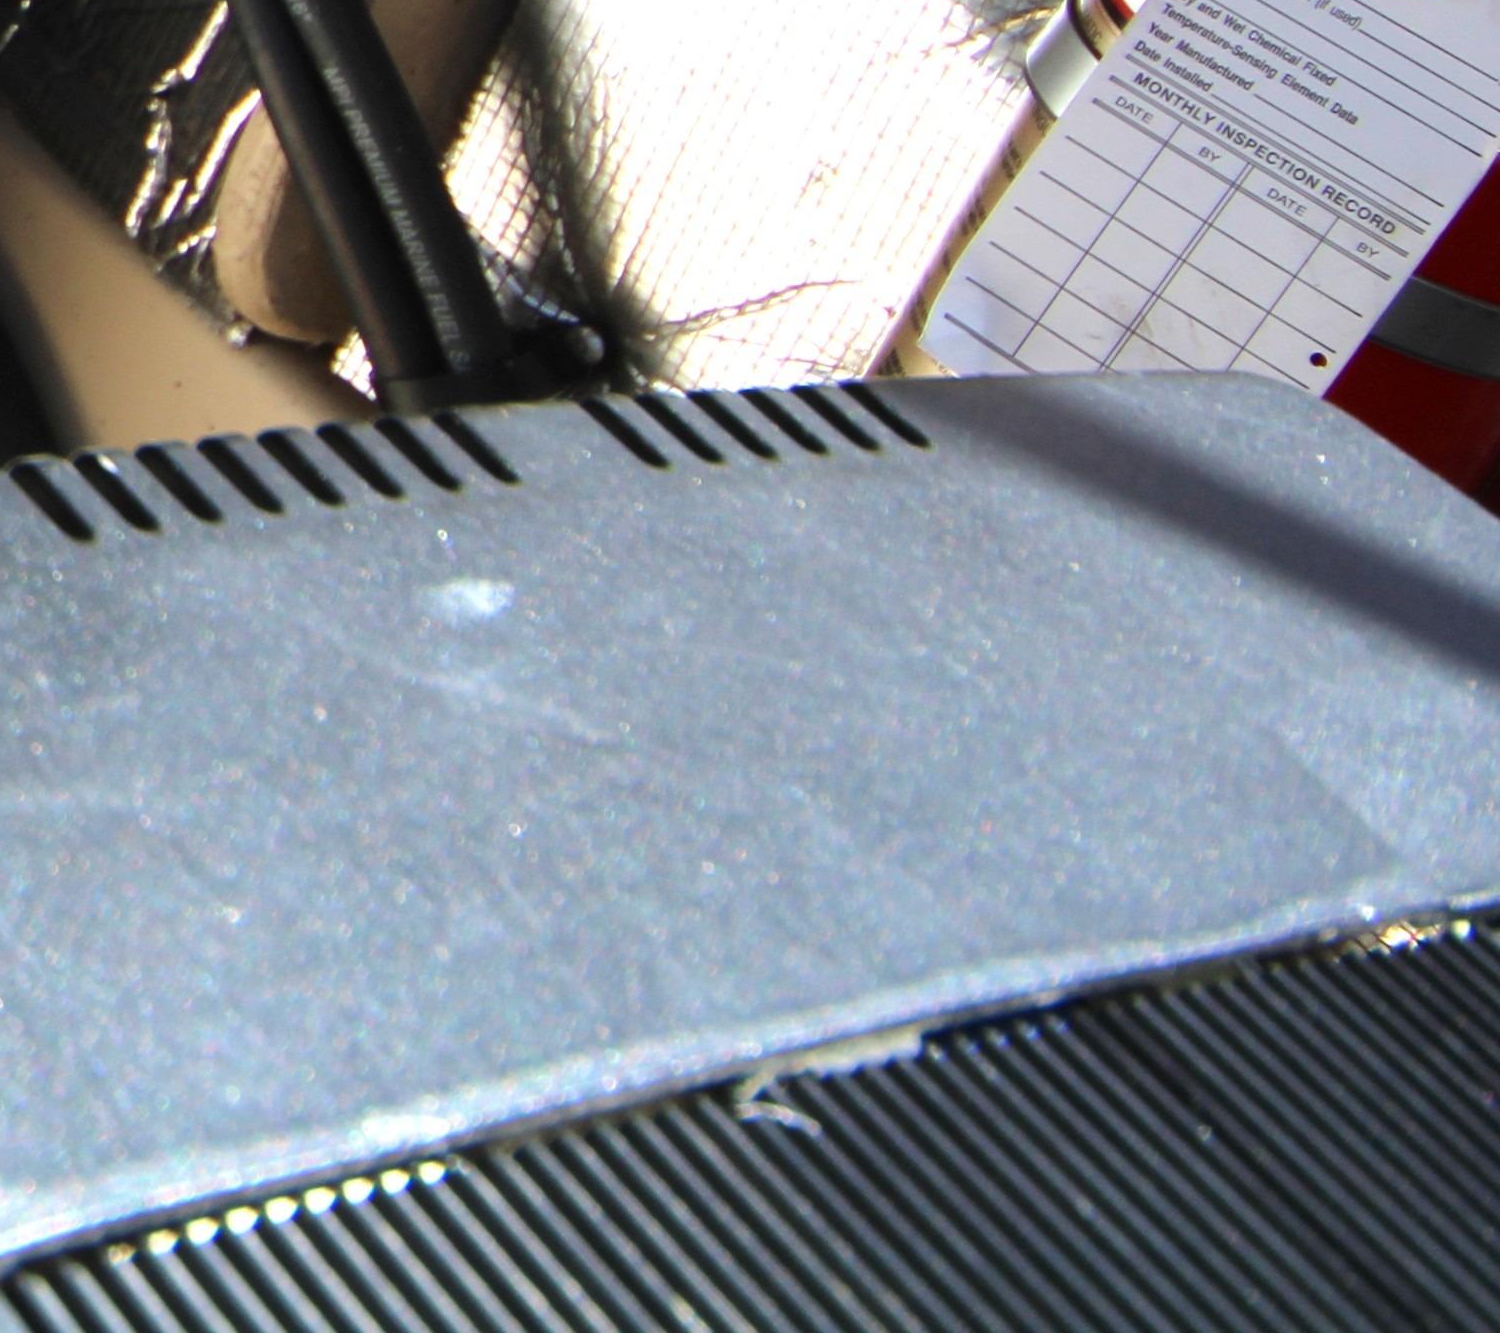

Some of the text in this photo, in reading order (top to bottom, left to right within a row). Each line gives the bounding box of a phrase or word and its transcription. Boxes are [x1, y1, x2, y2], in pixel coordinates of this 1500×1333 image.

[1196, 2, 1221, 19] and
[1223, 13, 1246, 34] Wet
[1247, 29, 1302, 65] Chemical
[1302, 61, 1337, 86] Fixed
[1329, 6, 1362, 31] used)
[1133, 39, 1213, 91] Date Installed
[1148, 21, 1174, 42] Year
[1175, 39, 1254, 90] Manufactured
[1161, 2, 1358, 125] Temperature-Sensing Element Data
[1113, 95, 1155, 125] DATE
[1133, 72, 1396, 234] MONTHLY INSPECTION RECORD
[1197, 145, 1223, 165] BY
[1265, 188, 1308, 218] DATE
[387, 207, 439, 291] MARINE
[1355, 241, 1380, 259] BY
